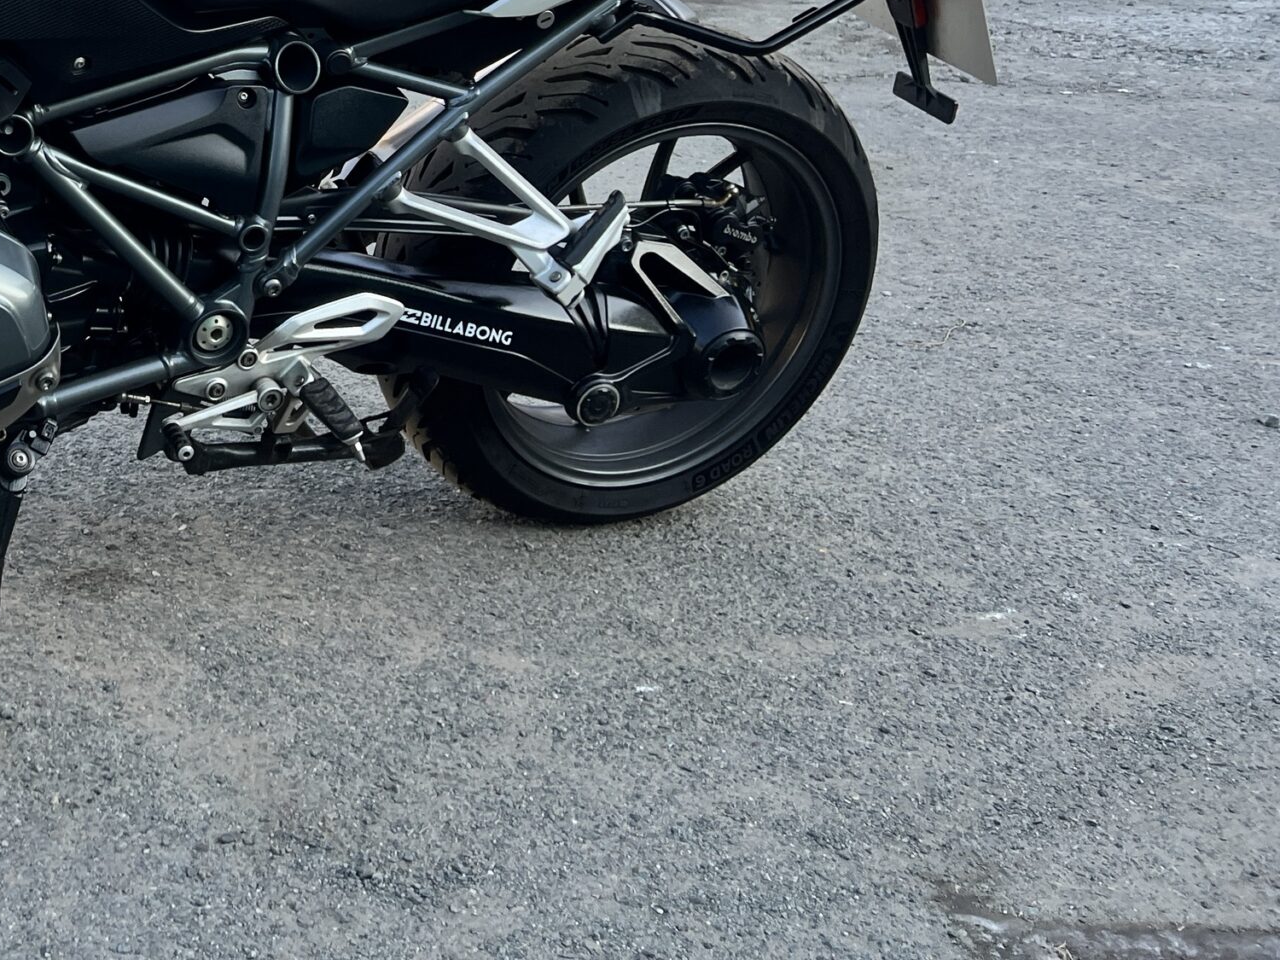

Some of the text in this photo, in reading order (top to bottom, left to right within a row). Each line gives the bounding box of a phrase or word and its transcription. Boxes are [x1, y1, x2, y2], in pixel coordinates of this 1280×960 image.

[723, 223, 757, 244] brembo
[419, 311, 513, 346] BILLABONG
[709, 443, 754, 480] ROAD
